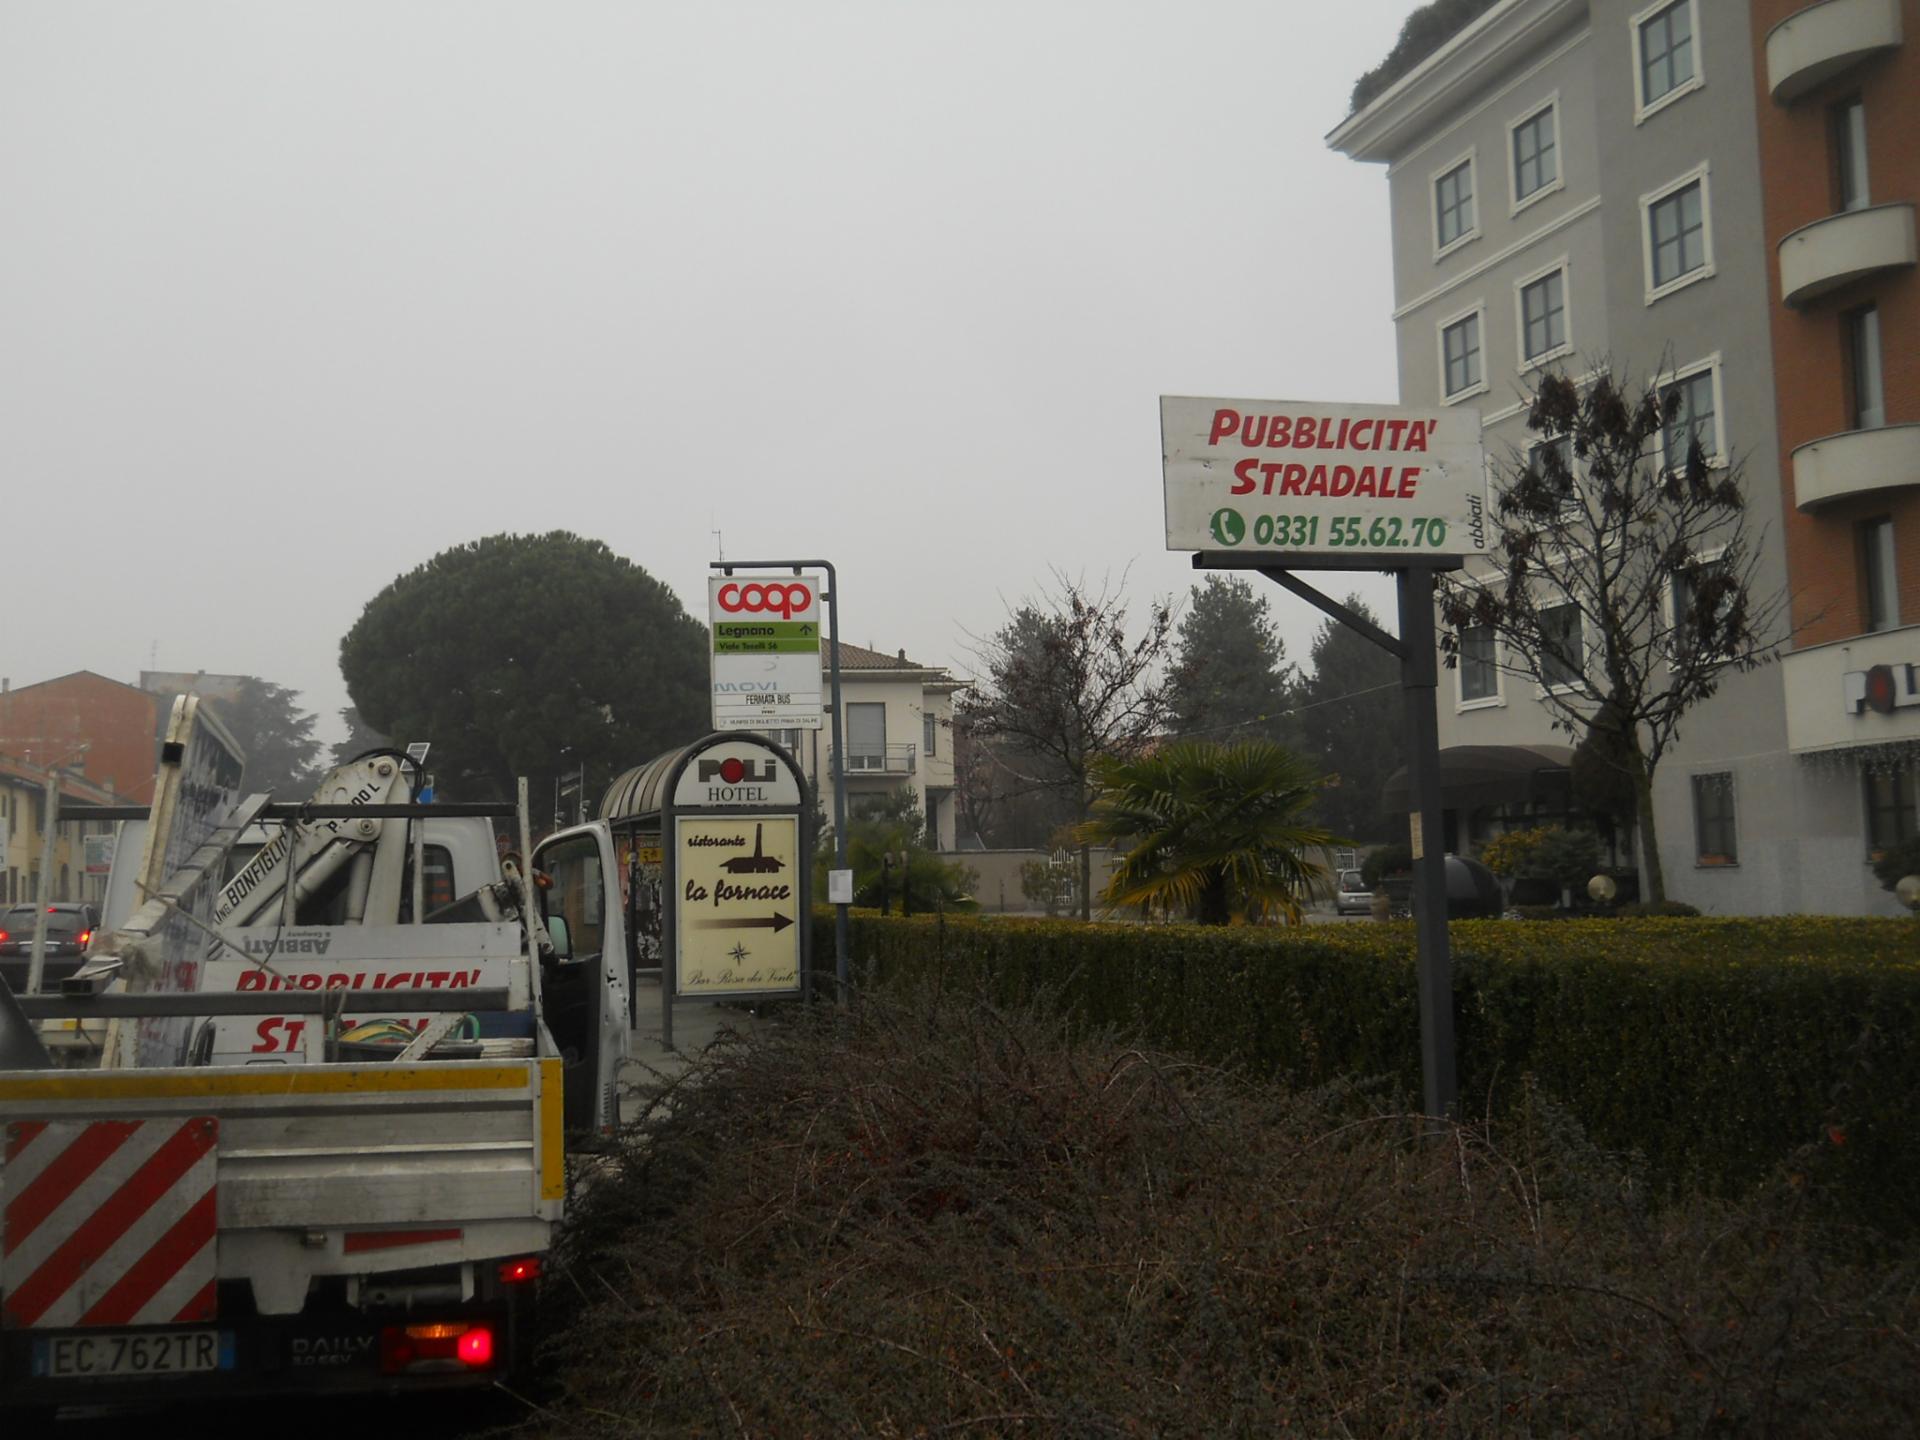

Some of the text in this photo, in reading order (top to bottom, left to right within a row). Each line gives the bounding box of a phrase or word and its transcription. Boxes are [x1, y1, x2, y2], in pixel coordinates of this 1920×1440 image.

[1208, 408, 1437, 452] PUBBLICITA'
[1230, 458, 1422, 499] STRADALE
[1466, 493, 1485, 550] abbiati
[1253, 515, 1446, 548] 0331 55.62.70
[717, 582, 812, 621] coop
[718, 625, 775, 638] Legnano
[720, 641, 740, 651] Viale
[715, 682, 777, 692] MOVI
[746, 694, 791, 705] FERMATA BUS
[708, 787, 769, 802] HOTEL
[687, 835, 746, 849] ristorante
[685, 879, 790, 907] la fornace
[244, 936, 332, 954] ABBIATI
[54, 1333, 216, 1374] EC 762TR
[291, 1335, 374, 1354] DAILY
